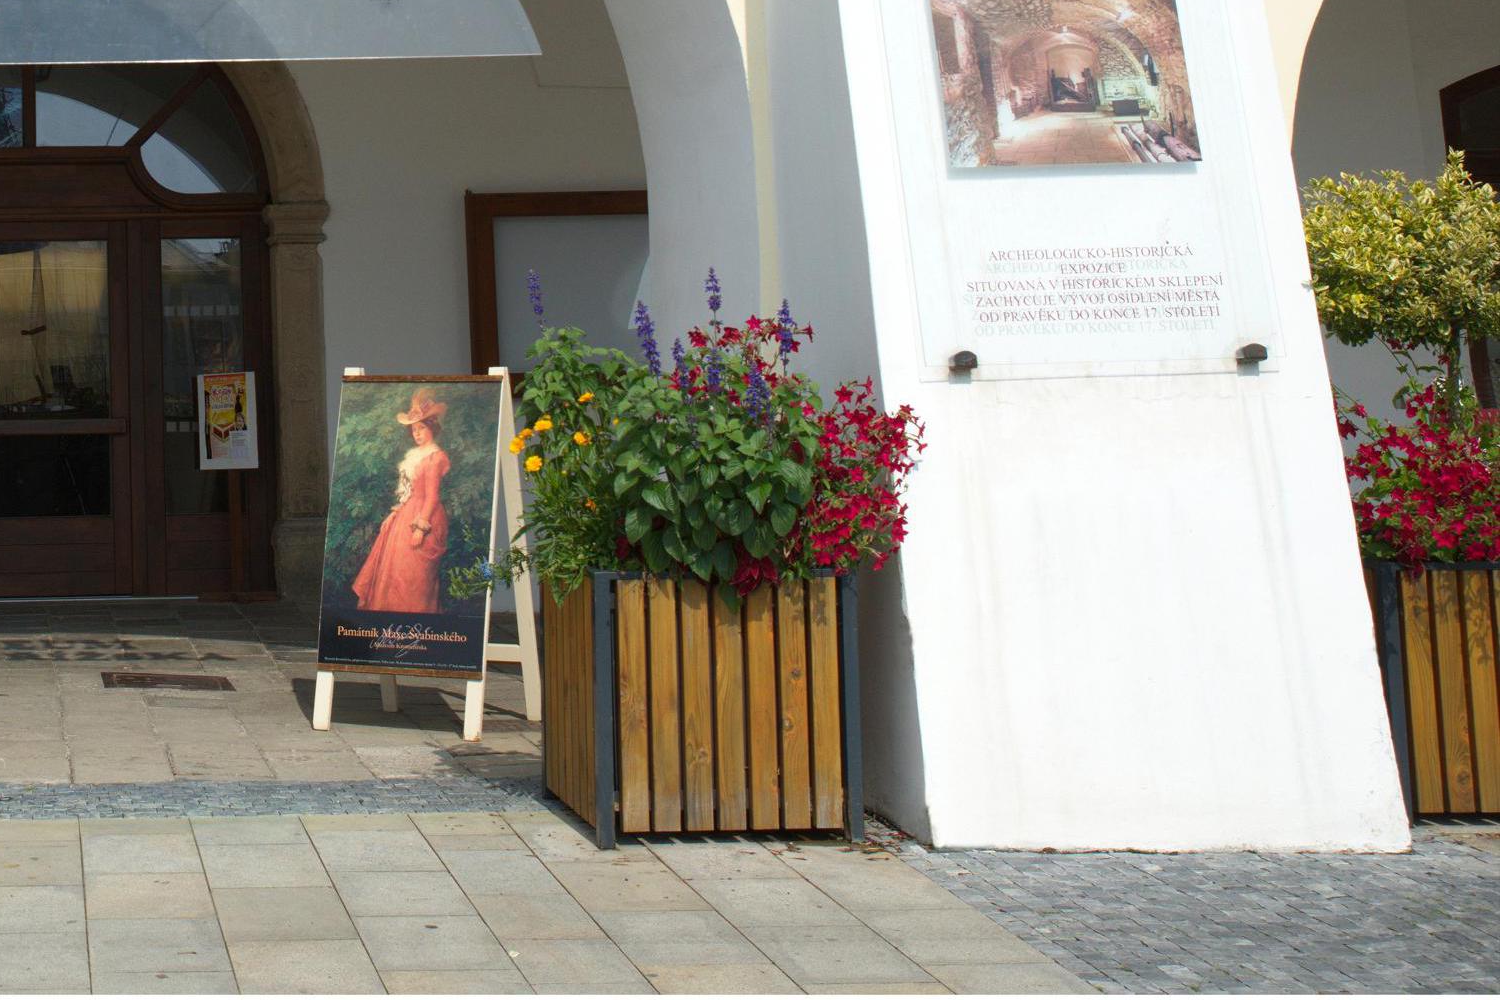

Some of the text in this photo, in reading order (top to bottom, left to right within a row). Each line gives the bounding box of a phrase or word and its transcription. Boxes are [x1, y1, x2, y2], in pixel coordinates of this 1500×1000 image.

[988, 243, 1193, 261] ARCHEOLOGICKO-HISTORICKÁ
[1060, 262, 1126, 275] EXPOZICE
[966, 272, 1223, 292] SITUOVANÁ V HISTORICKÉM SKLEPENÍ
[975, 289, 1221, 307] ZACHYCUJE VÝVOJ OSÍDLENÍ MĚSTA
[979, 311, 1000, 323] OD
[1003, 308, 1065, 322] PRAVĚKU
[1070, 309, 1090, 321] DO
[1093, 307, 1141, 320] KONCE
[1163, 303, 1221, 318] STOLETÍ
[337, 625, 468, 643] Památník Maxe Švabinského
